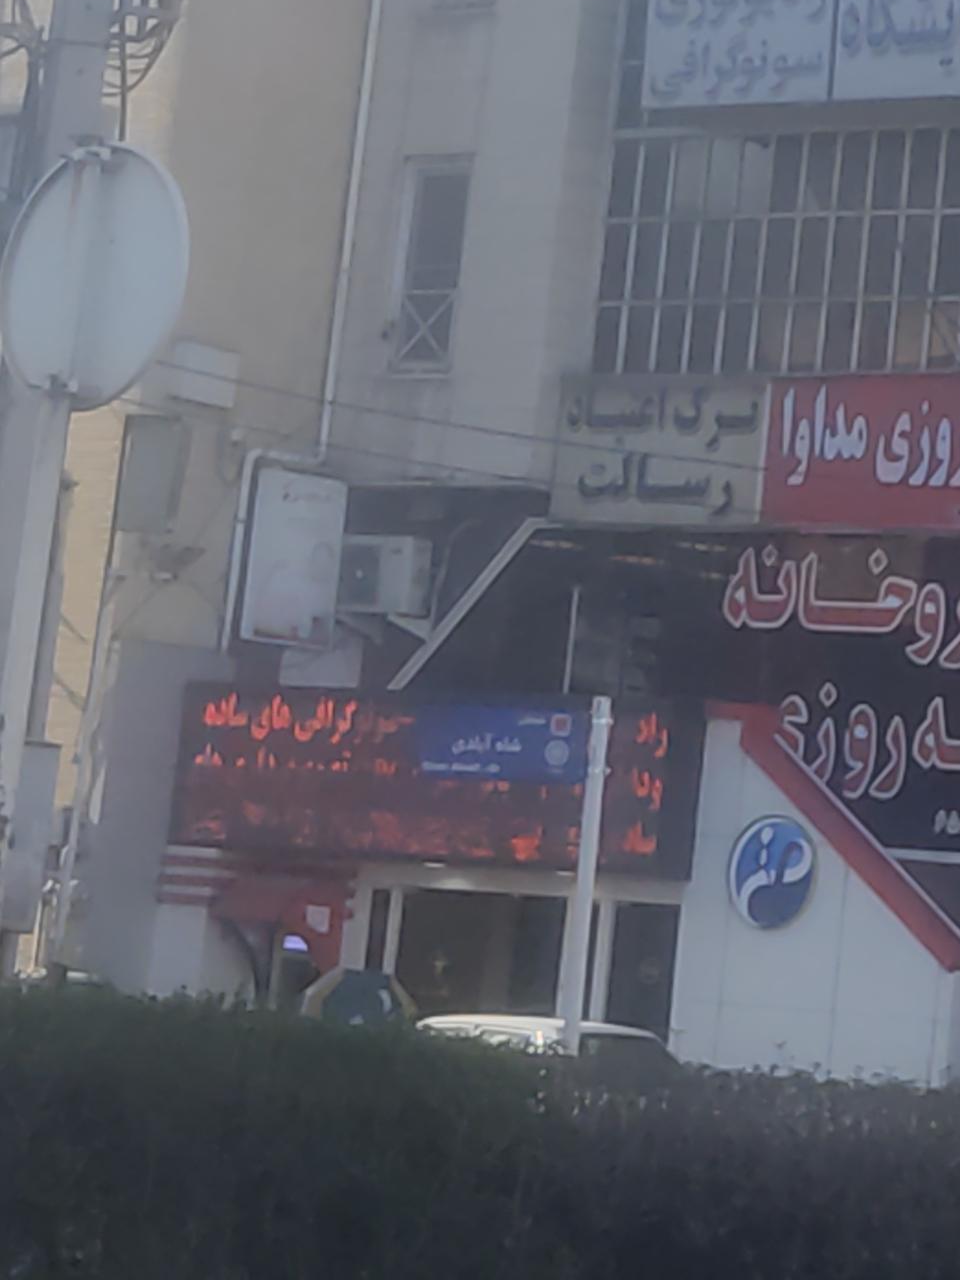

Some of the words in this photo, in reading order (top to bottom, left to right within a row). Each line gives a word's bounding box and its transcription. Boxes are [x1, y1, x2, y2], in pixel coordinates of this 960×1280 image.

[651, 39, 825, 99] سونوگرافی
[779, 384, 868, 485] مداوا
[577, 451, 735, 517] رسالت
